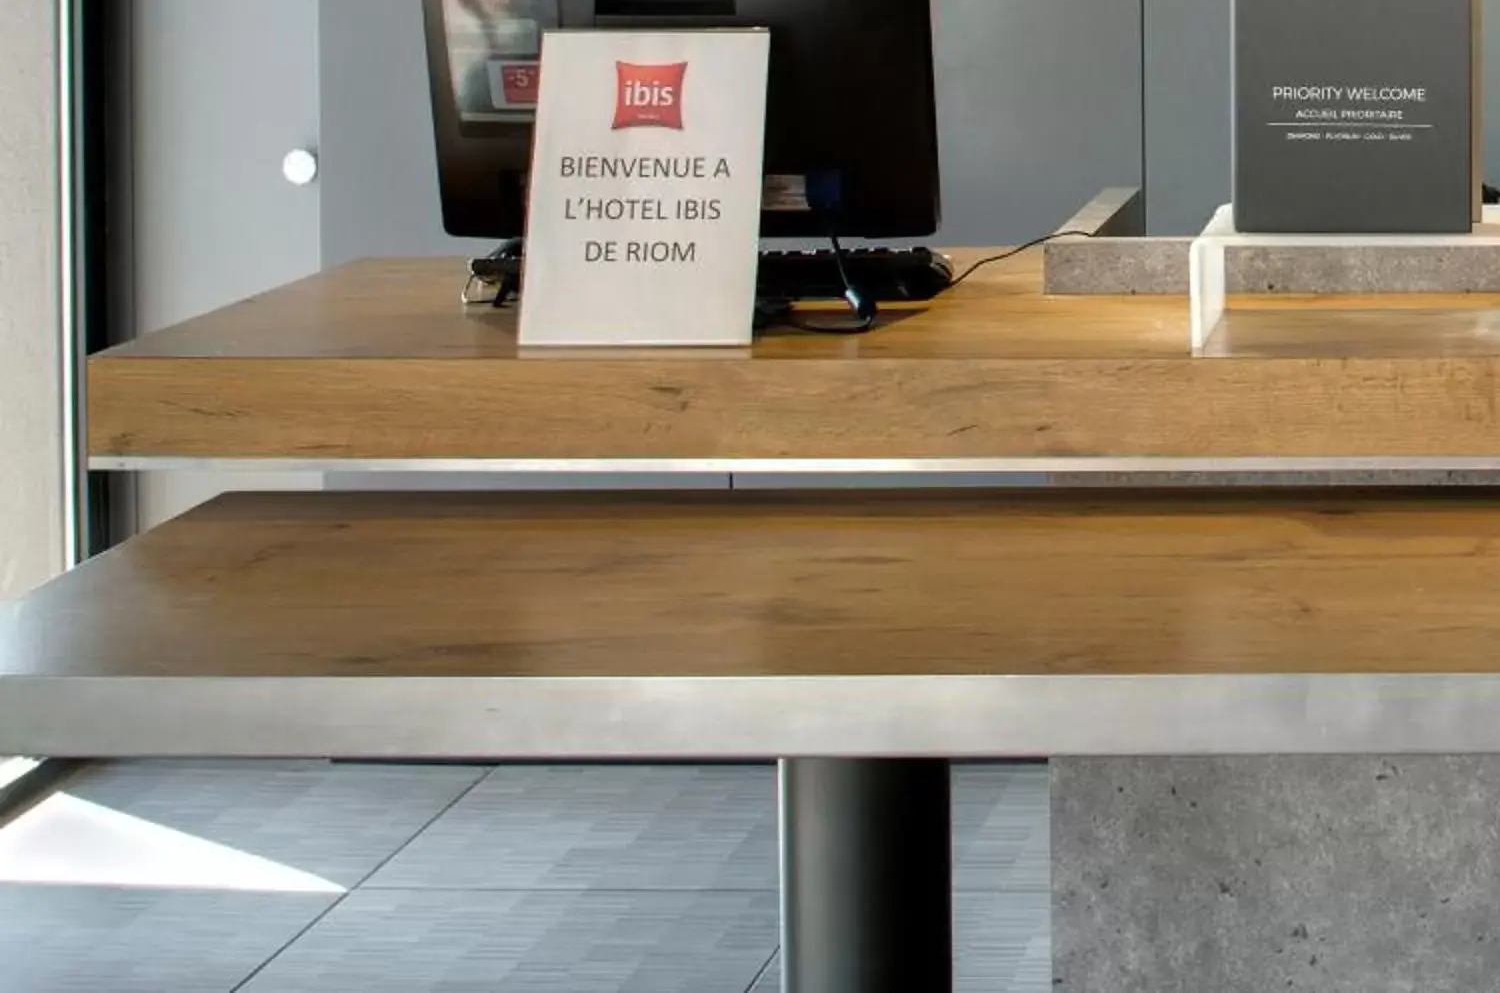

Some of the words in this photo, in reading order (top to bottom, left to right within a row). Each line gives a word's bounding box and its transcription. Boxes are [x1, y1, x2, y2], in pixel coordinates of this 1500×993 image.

[624, 80, 674, 107] ibis
[1272, 86, 1342, 101] PRIORITY
[1346, 86, 1428, 102] WELCOME
[1294, 108, 1339, 120] ACCUEIL
[560, 156, 706, 179] BIENVENUE
[713, 157, 731, 179] A
[565, 197, 668, 220] L'HOTEL
[676, 198, 721, 220] IBIS
[585, 241, 617, 262] DE
[627, 241, 695, 263] RIOM
